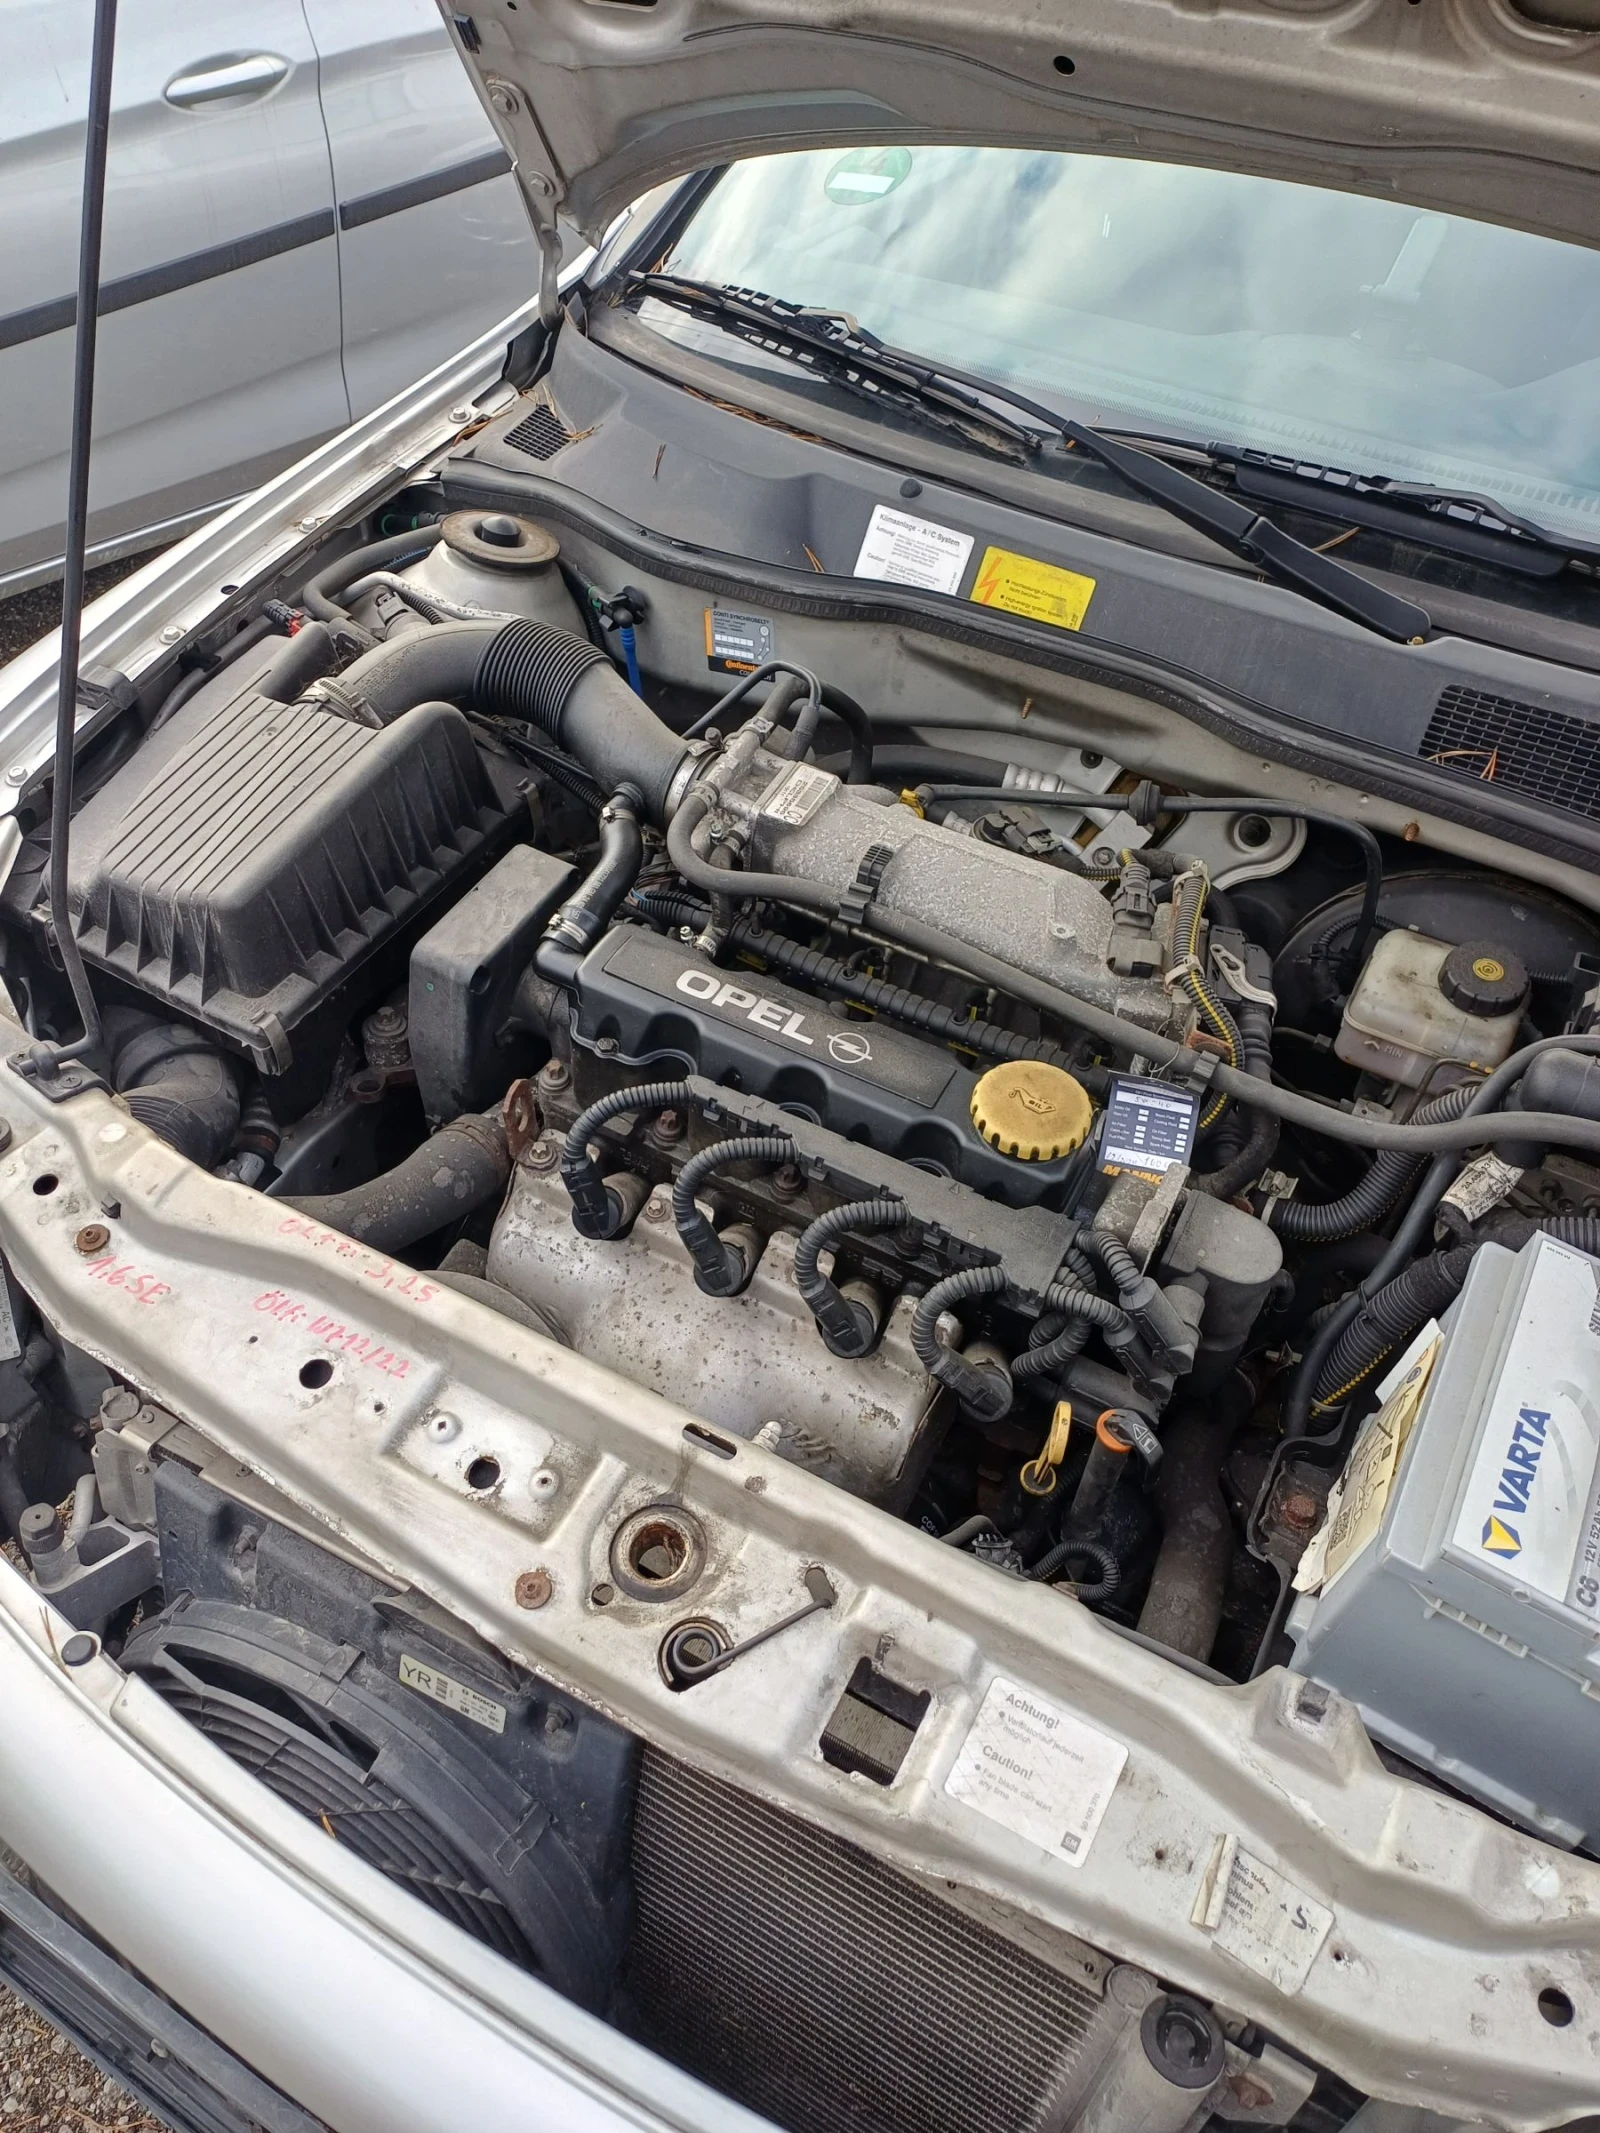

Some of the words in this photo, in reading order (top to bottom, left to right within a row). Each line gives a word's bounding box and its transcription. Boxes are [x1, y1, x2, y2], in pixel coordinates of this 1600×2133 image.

[880, 513, 916, 532] Klimaanlage
[937, 533, 960, 547] System
[676, 969, 814, 1046] OPEL
[1384, 1045, 1403, 1058] MIN
[1493, 1407, 1551, 1514] VARTA
[1585, 1540, 1598, 1564] 12V
[403, 1662, 432, 1689] YR
[472, 1694, 498, 1710] BOSCH
[1005, 1693, 1060, 1729] Achtung!
[1003, 1725, 1031, 1744] möglich
[983, 1745, 1033, 1780] Caution!
[1053, 1741, 1084, 1764] jederzeit
[978, 1778, 992, 1791] any
[993, 1786, 1010, 1800] time
[982, 1768, 997, 1781] Fan
[998, 1775, 1019, 1792] blade
[1020, 1789, 1035, 1802] can
[1036, 1797, 1052, 1813] start
